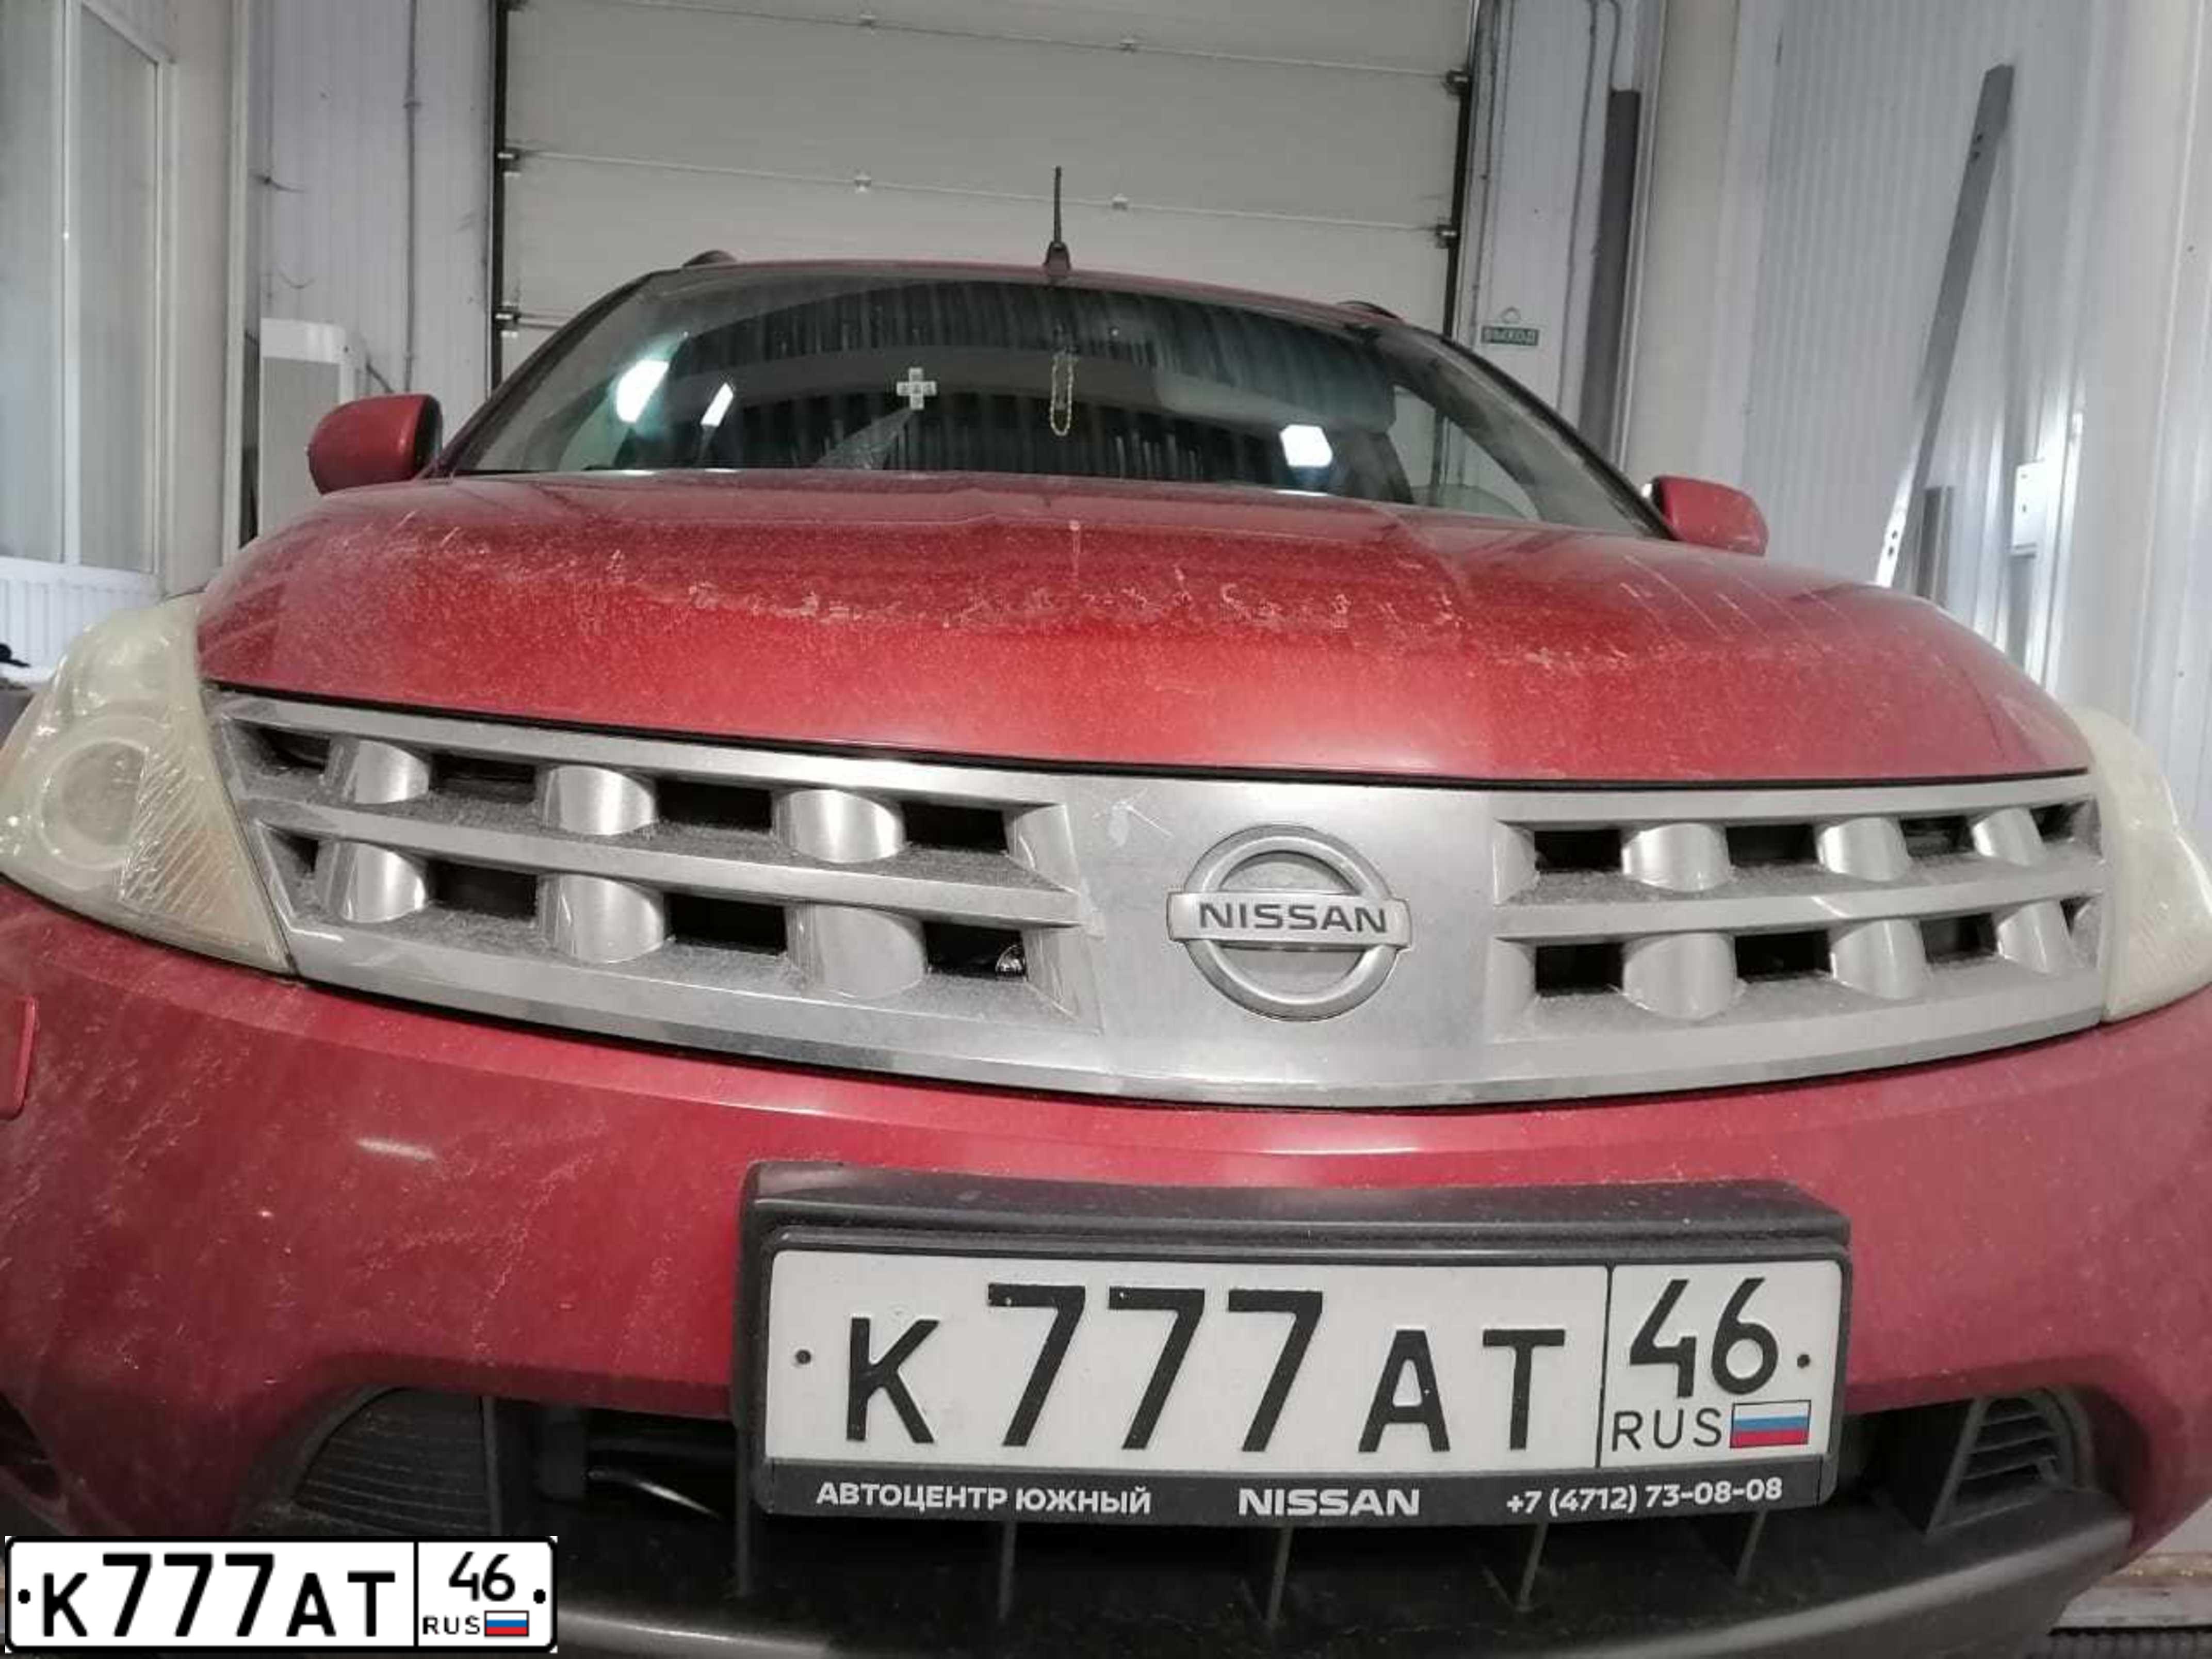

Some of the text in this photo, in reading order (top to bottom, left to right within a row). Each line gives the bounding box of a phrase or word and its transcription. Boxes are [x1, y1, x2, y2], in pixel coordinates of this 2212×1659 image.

[1200, 903, 1387, 933] NISSAN
[1630, 1277, 1778, 1397] 46
[1612, 1407, 1722, 1452] RUS
[816, 1482, 1152, 1514] АВТОЦЕНТР ЮЖНЫЙ
[1238, 1488, 1420, 1517] NISSAN
[1506, 1476, 1783, 1517] +7 (4712) 73-08-08
